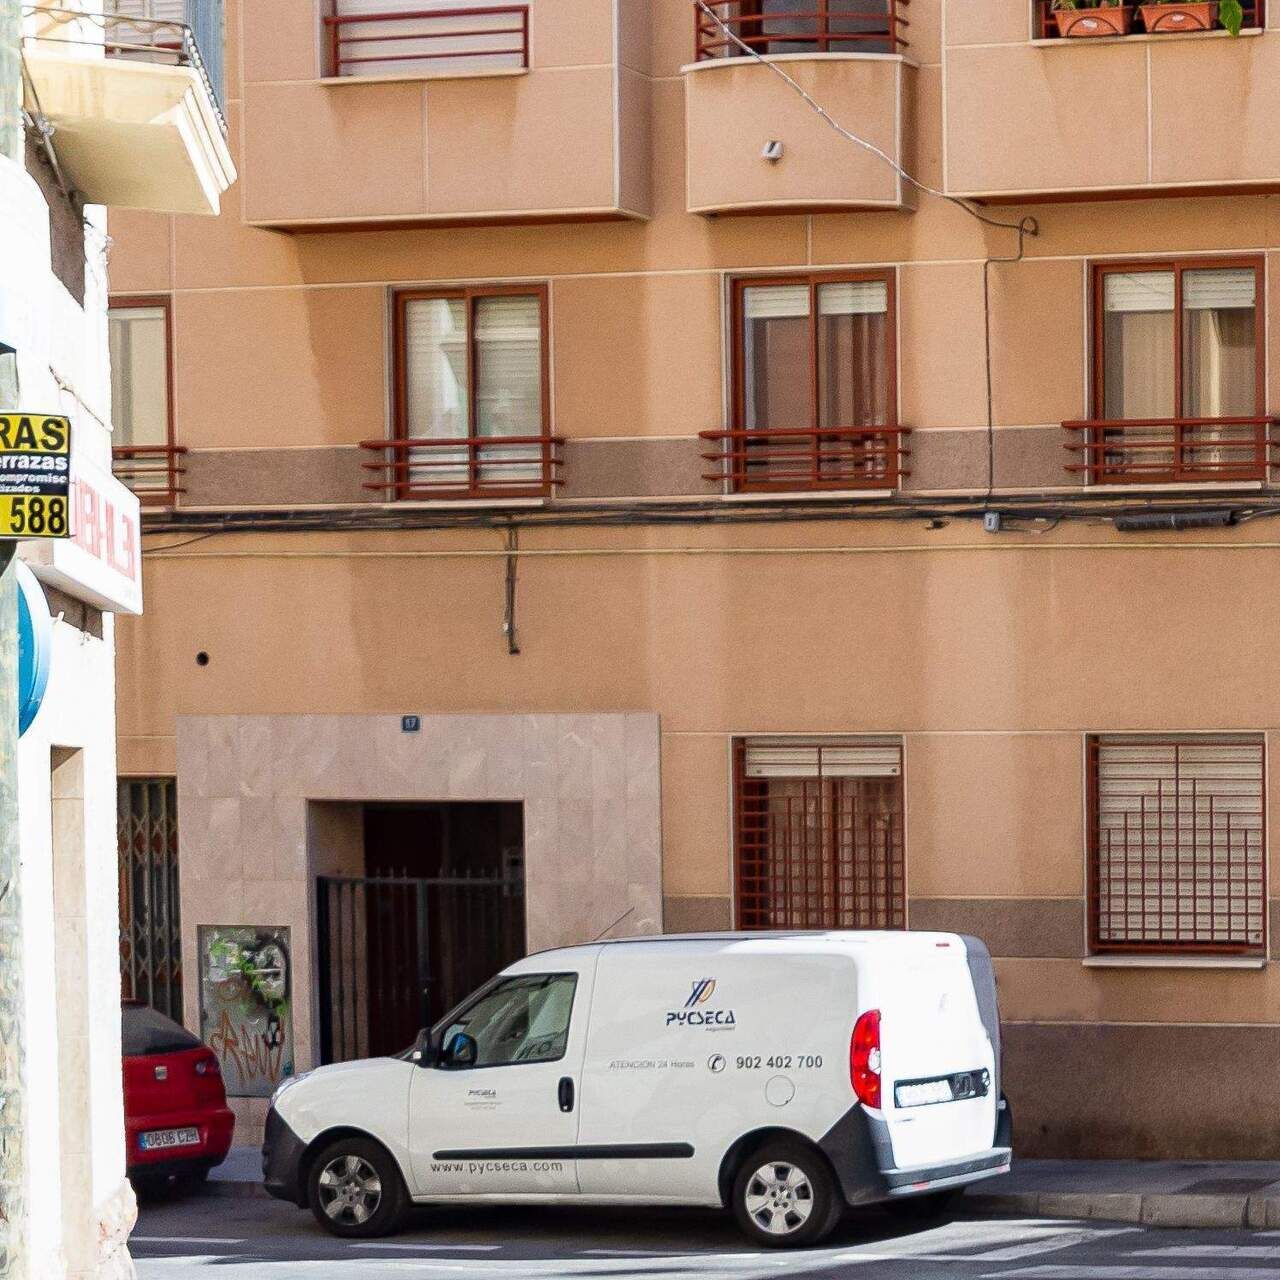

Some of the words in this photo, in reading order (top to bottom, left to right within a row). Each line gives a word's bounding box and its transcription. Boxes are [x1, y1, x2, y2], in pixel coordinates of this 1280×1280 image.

[0, 455, 67, 470] rrazas
[10, 497, 65, 534] 588
[665, 1009, 736, 1026] PYCSECA
[736, 1056, 761, 1069] 902
[766, 1056, 792, 1069] 402
[797, 1055, 823, 1068] 700
[430, 1160, 563, 1174] www.pycseca.com
